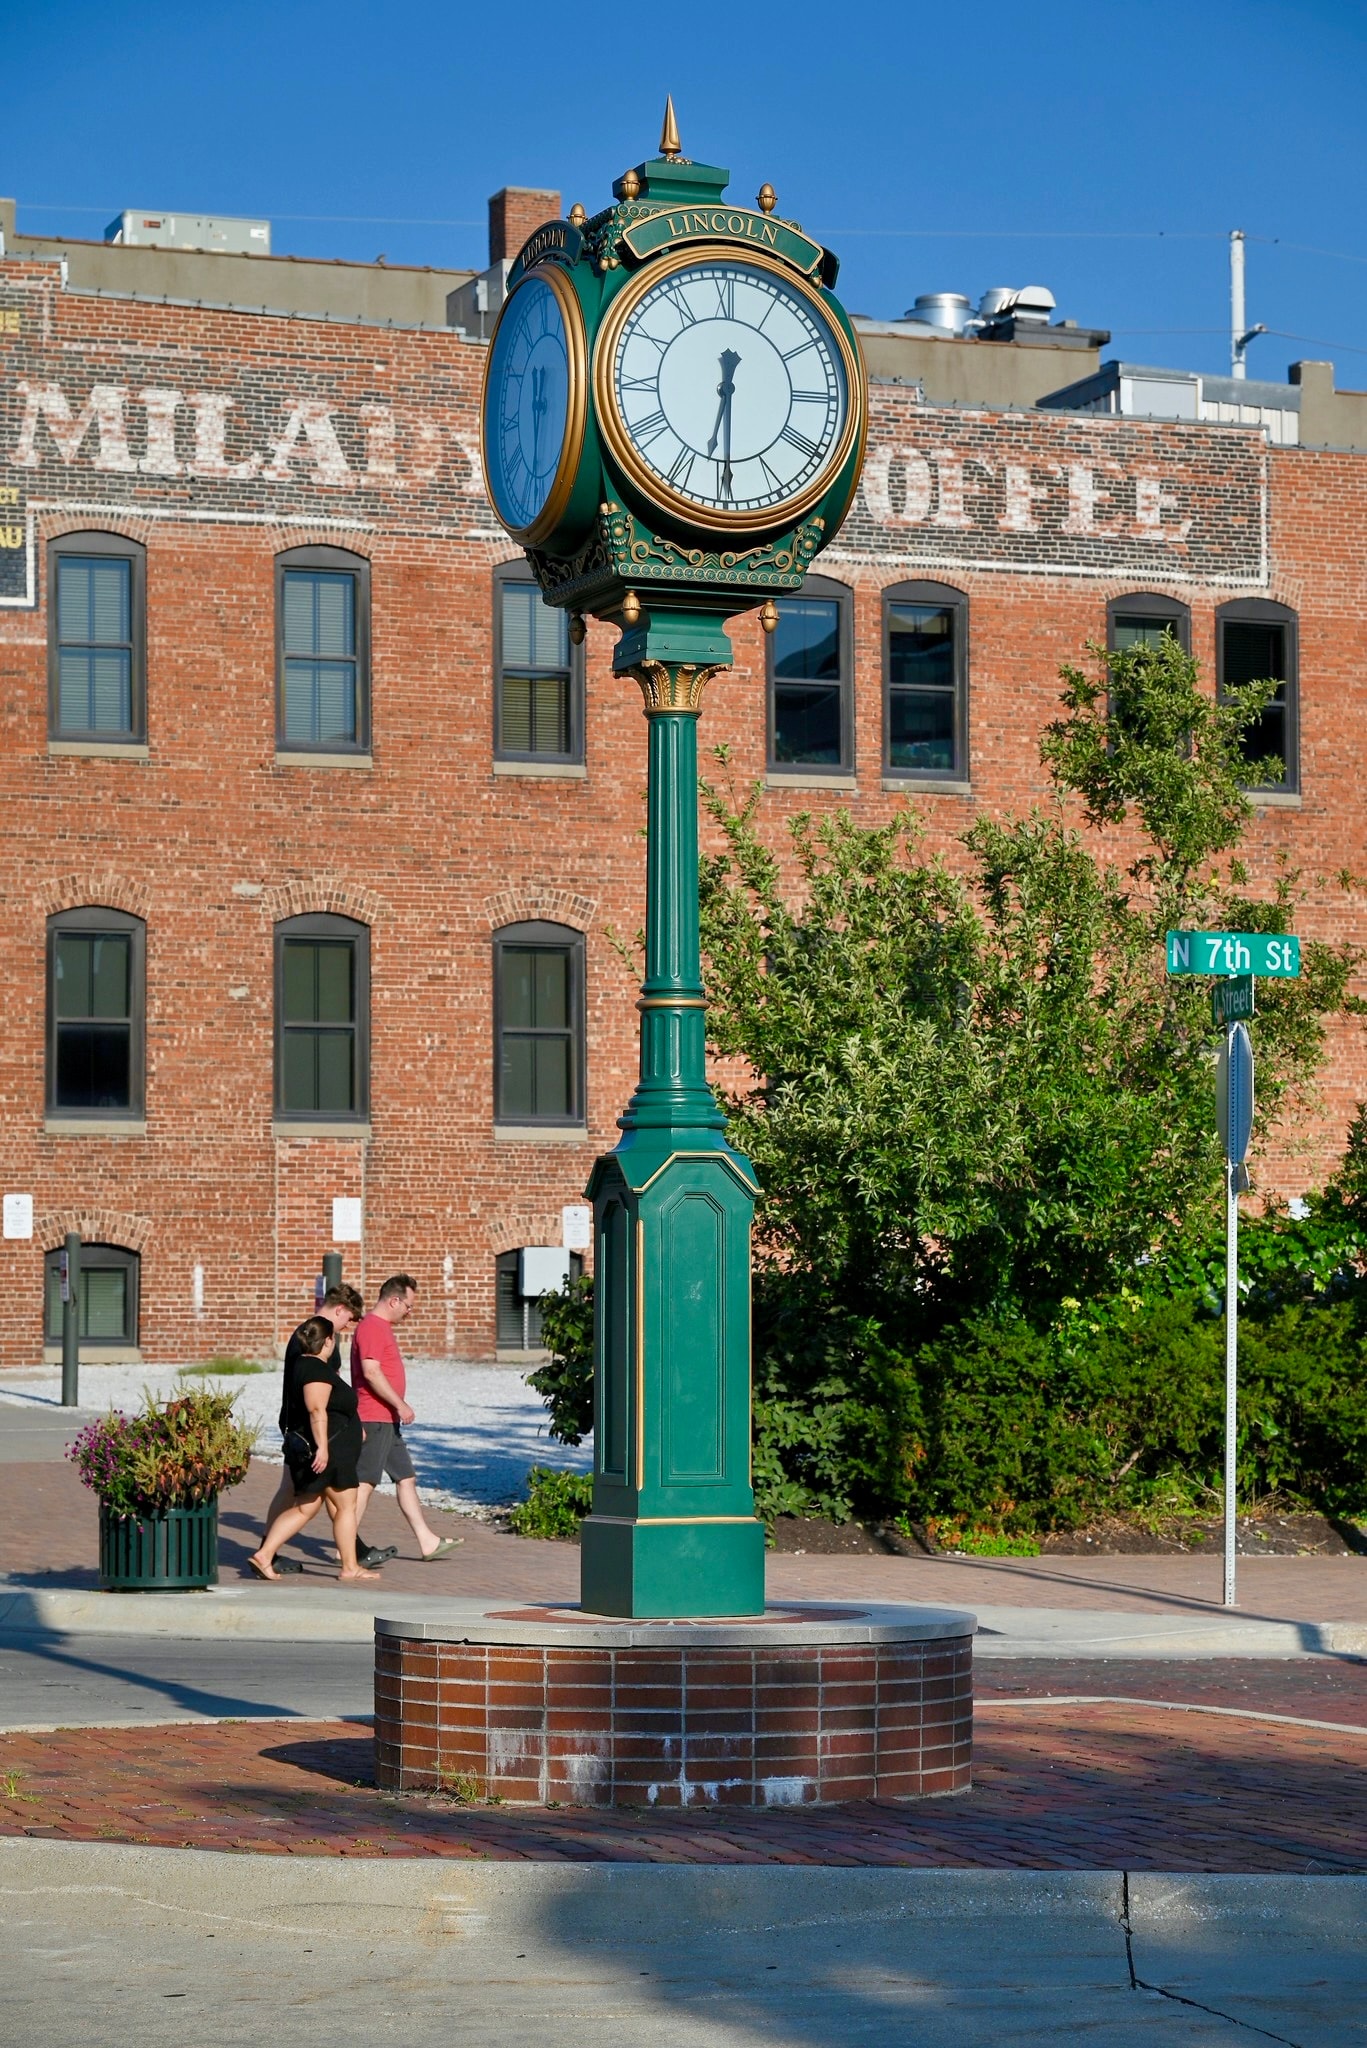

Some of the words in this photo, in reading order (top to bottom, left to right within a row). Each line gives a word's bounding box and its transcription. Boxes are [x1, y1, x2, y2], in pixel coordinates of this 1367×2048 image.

[666, 212, 779, 246] LINCOLN
[522, 229, 566, 269] LINCOLN
[847, 443, 1193, 542] OFFEE
[1173, 938, 1190, 967] N
[1206, 939, 1250, 969] 7th
[1266, 941, 1292, 971] St
[1221, 981, 1250, 1017] Street
